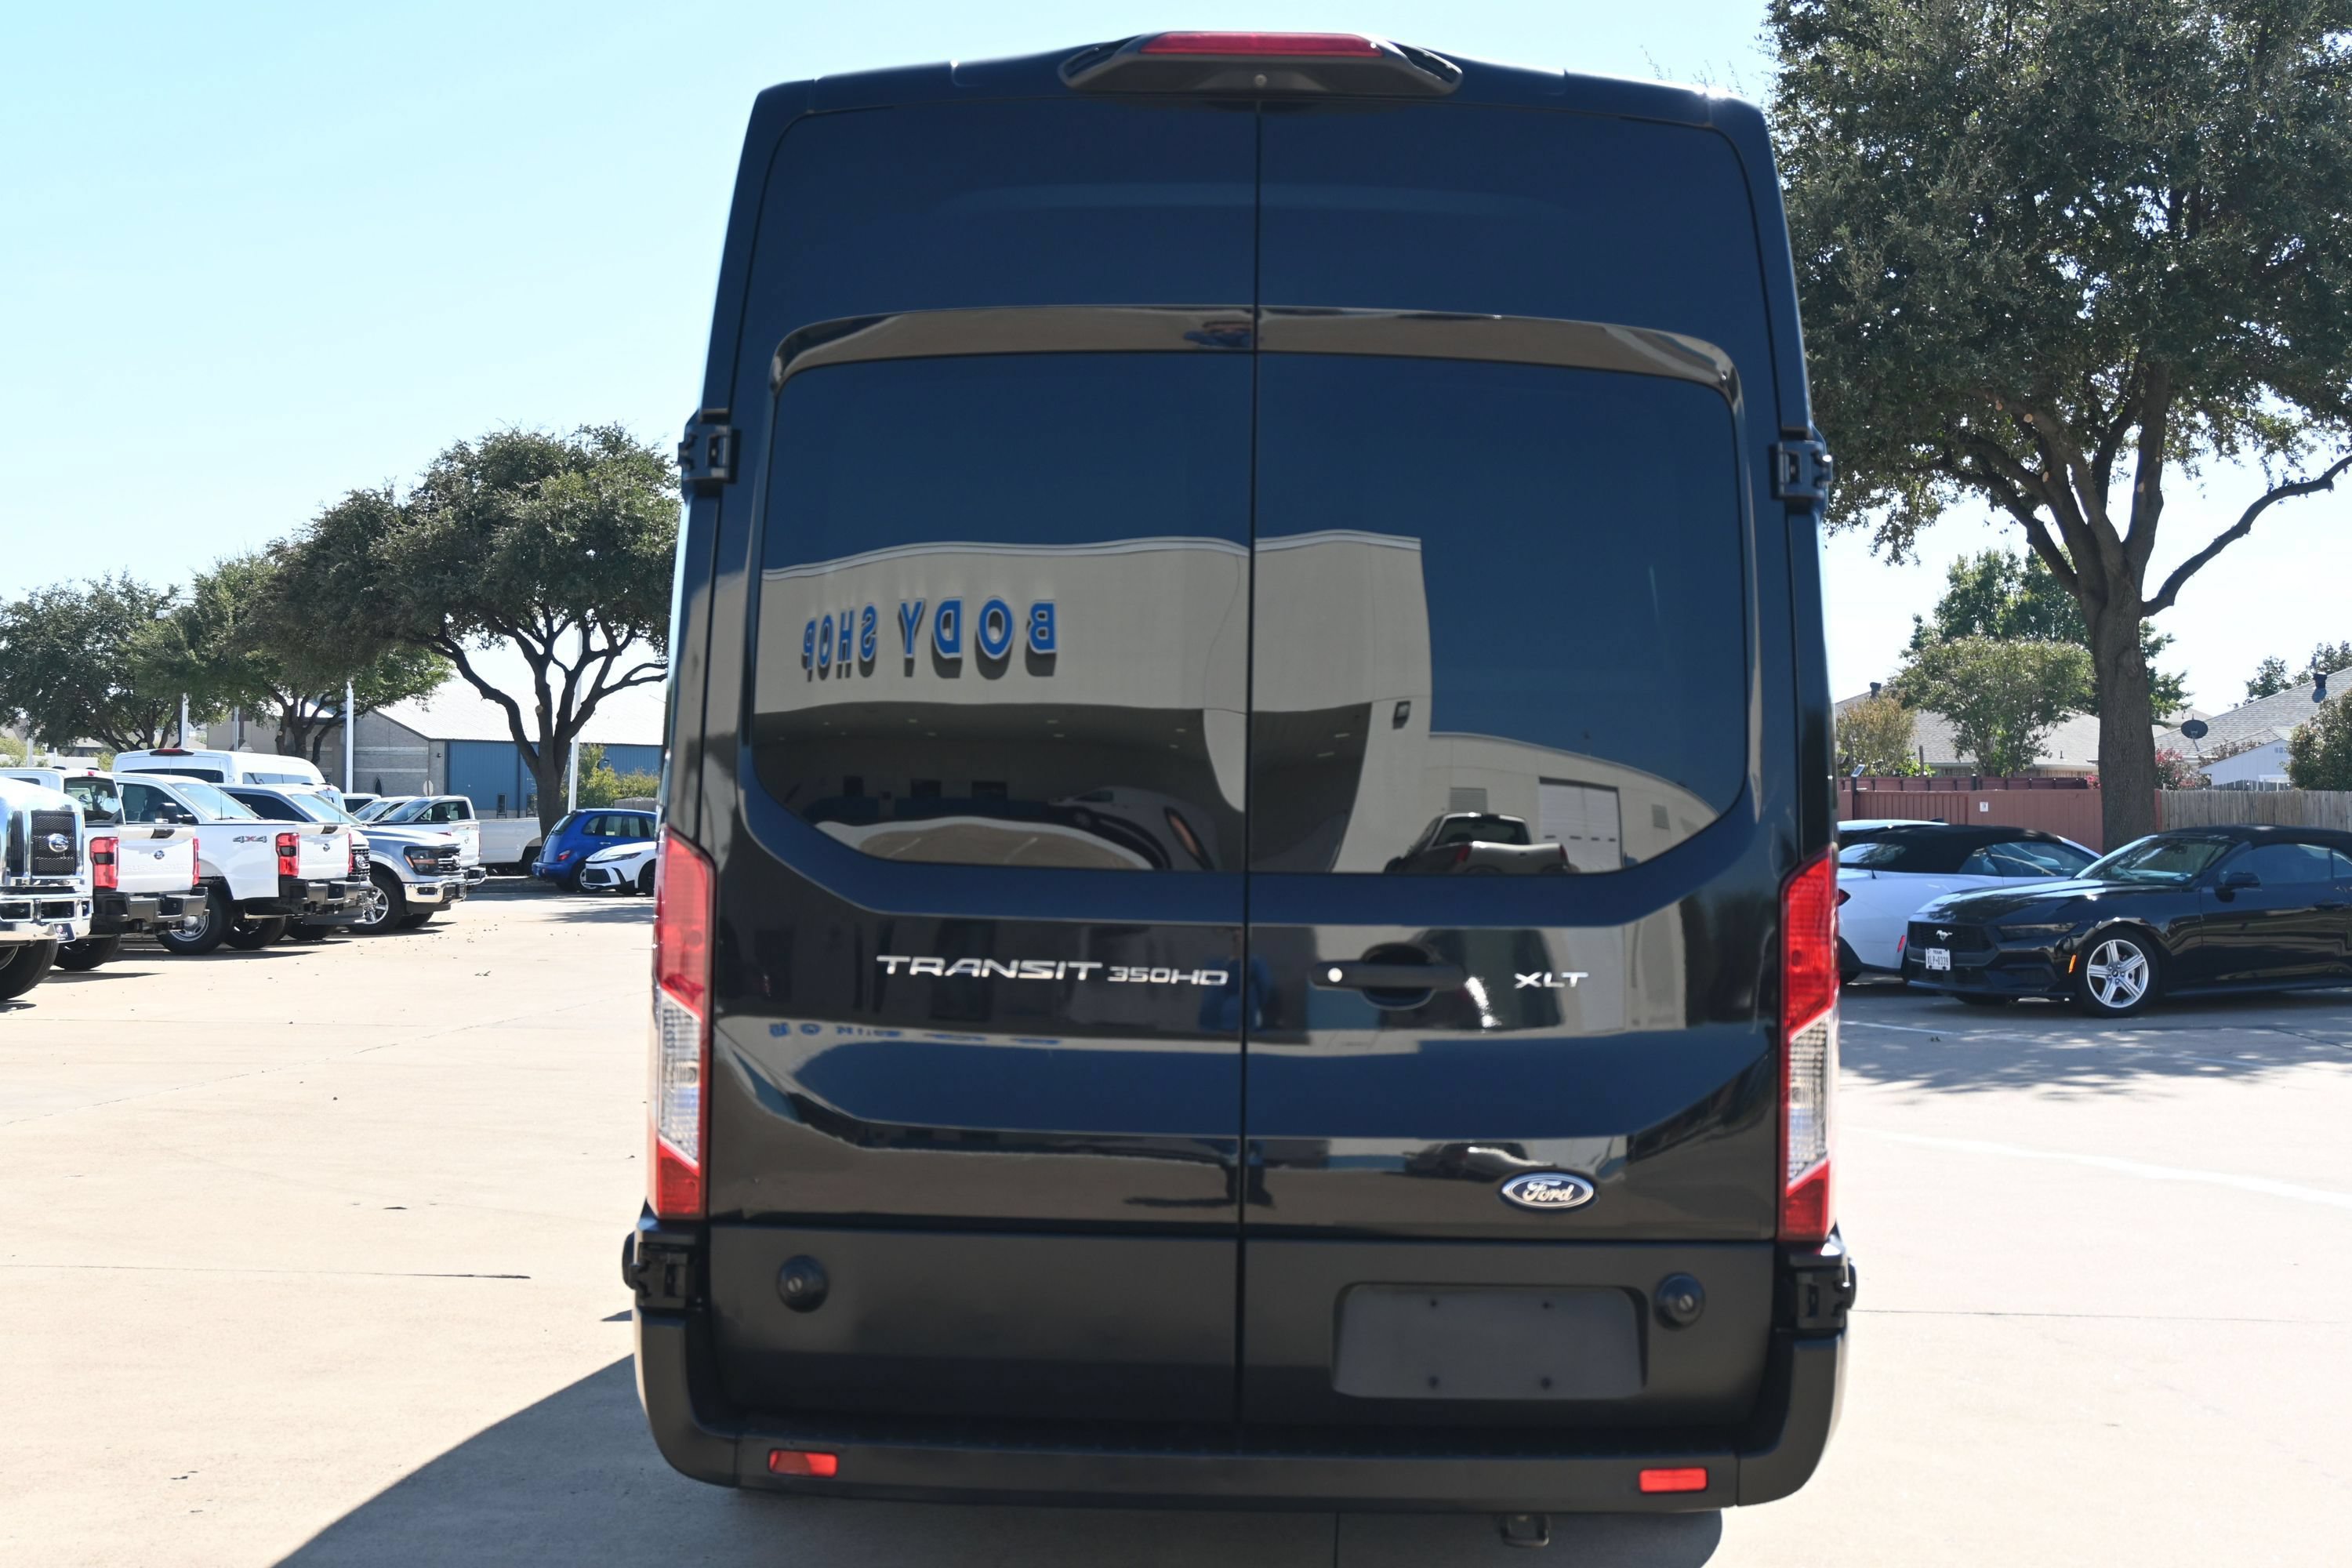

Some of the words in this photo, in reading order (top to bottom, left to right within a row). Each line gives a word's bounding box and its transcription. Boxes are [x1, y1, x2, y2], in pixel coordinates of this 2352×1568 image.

[876, 954, 1103, 981] TRANSIT
[1106, 965, 1229, 986] 350HD
[1513, 971, 1589, 989] XLT
[1522, 1179, 1575, 1202] Ford
